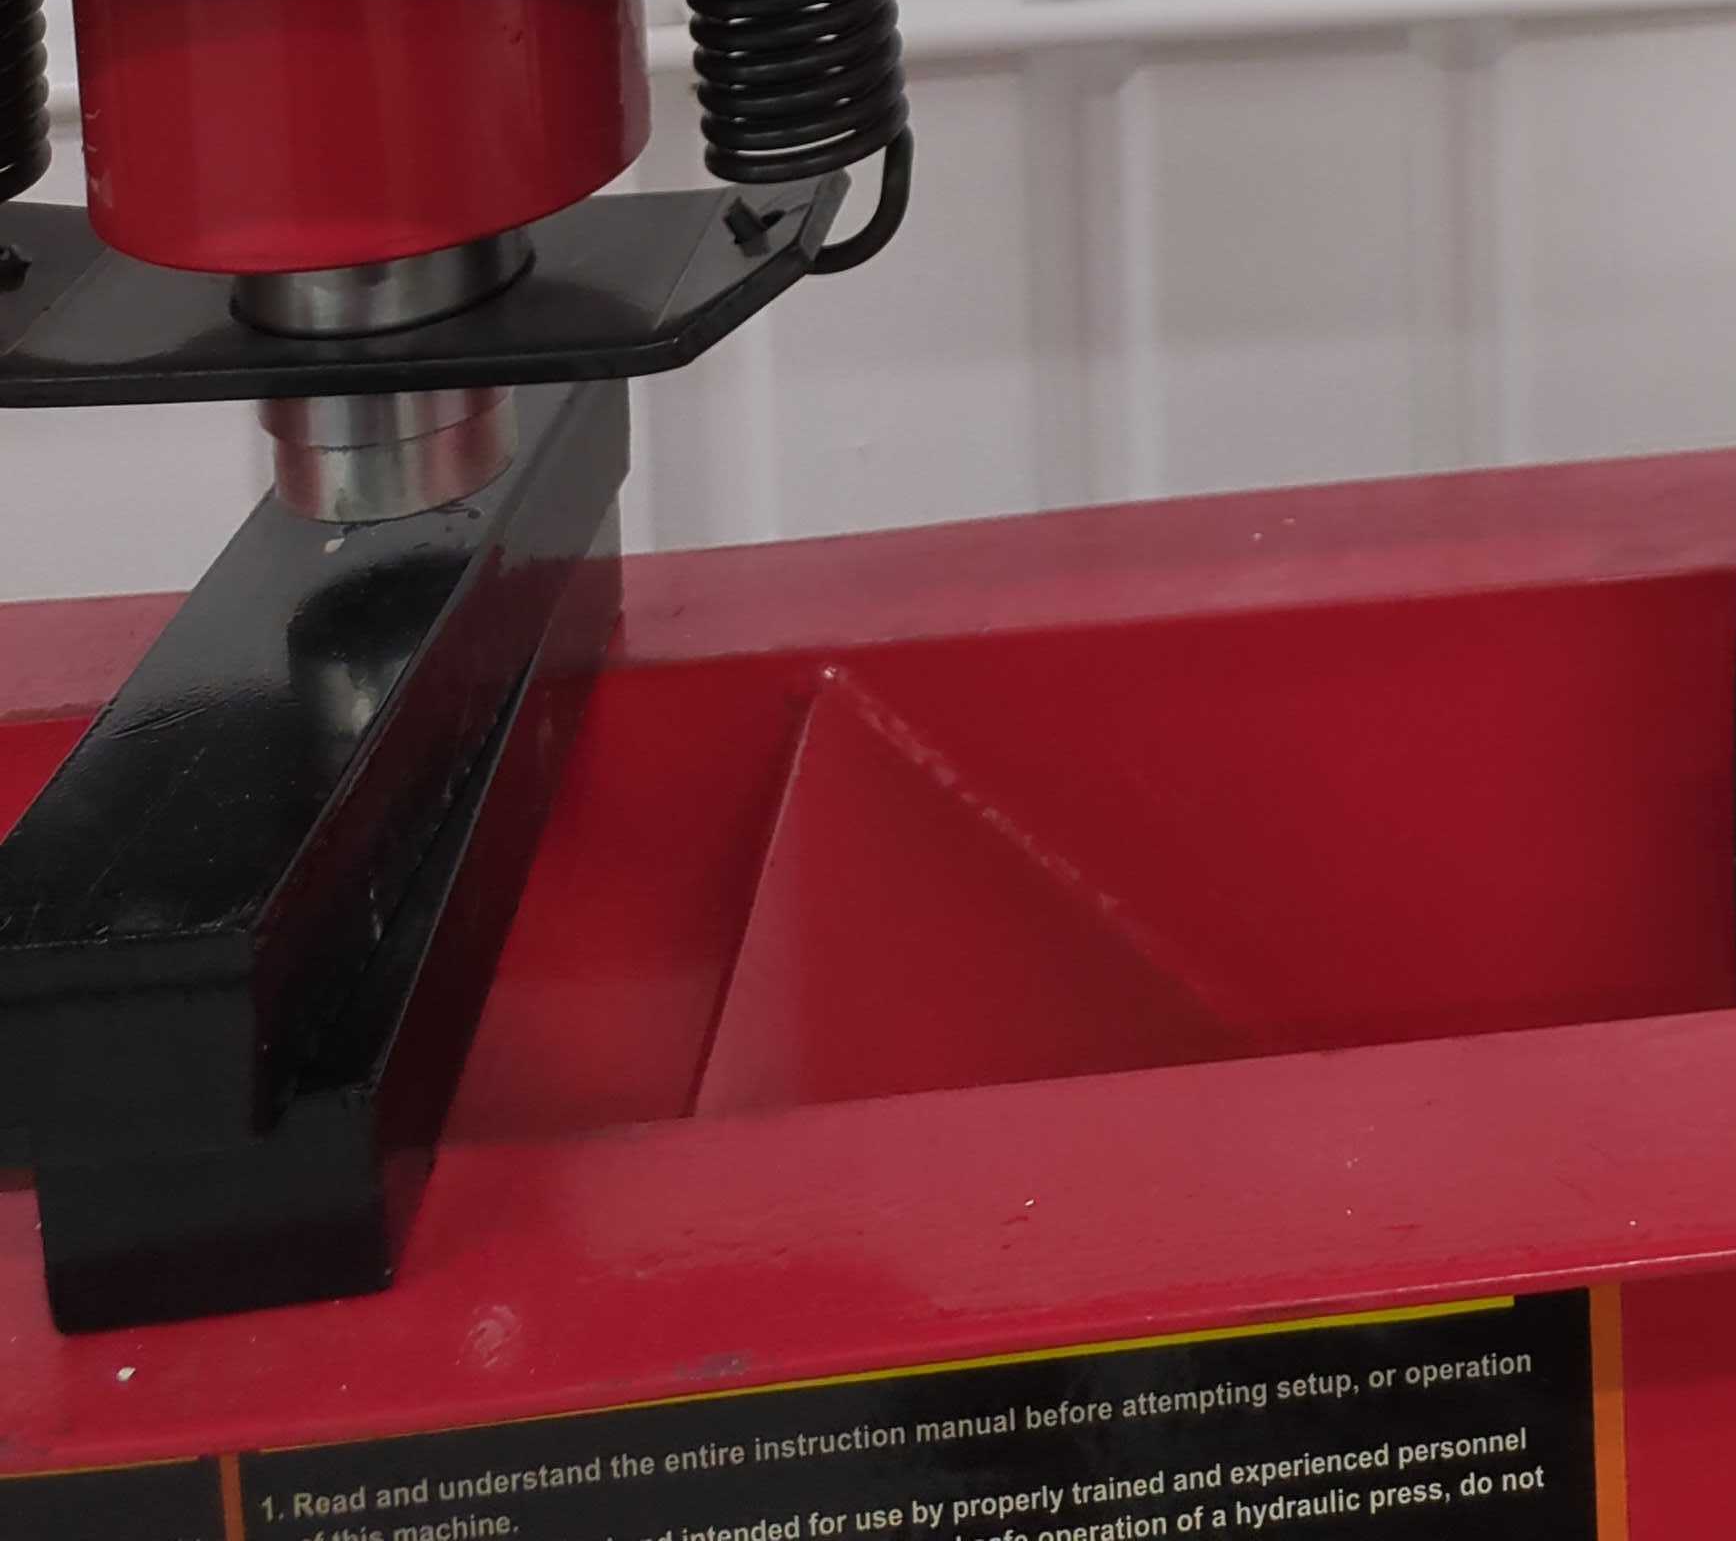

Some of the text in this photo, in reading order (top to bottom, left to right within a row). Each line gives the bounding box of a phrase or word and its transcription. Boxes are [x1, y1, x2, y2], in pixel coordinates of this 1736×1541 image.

[261, 1351, 1532, 1522] 1. Read and understand the entire instruction manual before attempting setup, or operation
[392, 1512, 519, 1541] machine.
[807, 1510, 848, 1538] for
[854, 1507, 904, 1532] use
[911, 1499, 944, 1529] by
[952, 1484, 1064, 1526] properly
[1070, 1469, 1165, 1506] trained
[1172, 1462, 1222, 1493] and
[1229, 1442, 1390, 1488] experienced
[1397, 1426, 1527, 1471] personnel
[1175, 1504, 1204, 1533] of
[1211, 1508, 1228, 1529] a
[1235, 1487, 1361, 1530] hydraulic
[1369, 1481, 1451, 1515] press,
[1459, 1472, 1493, 1497] do
[1501, 1465, 1545, 1493] not
